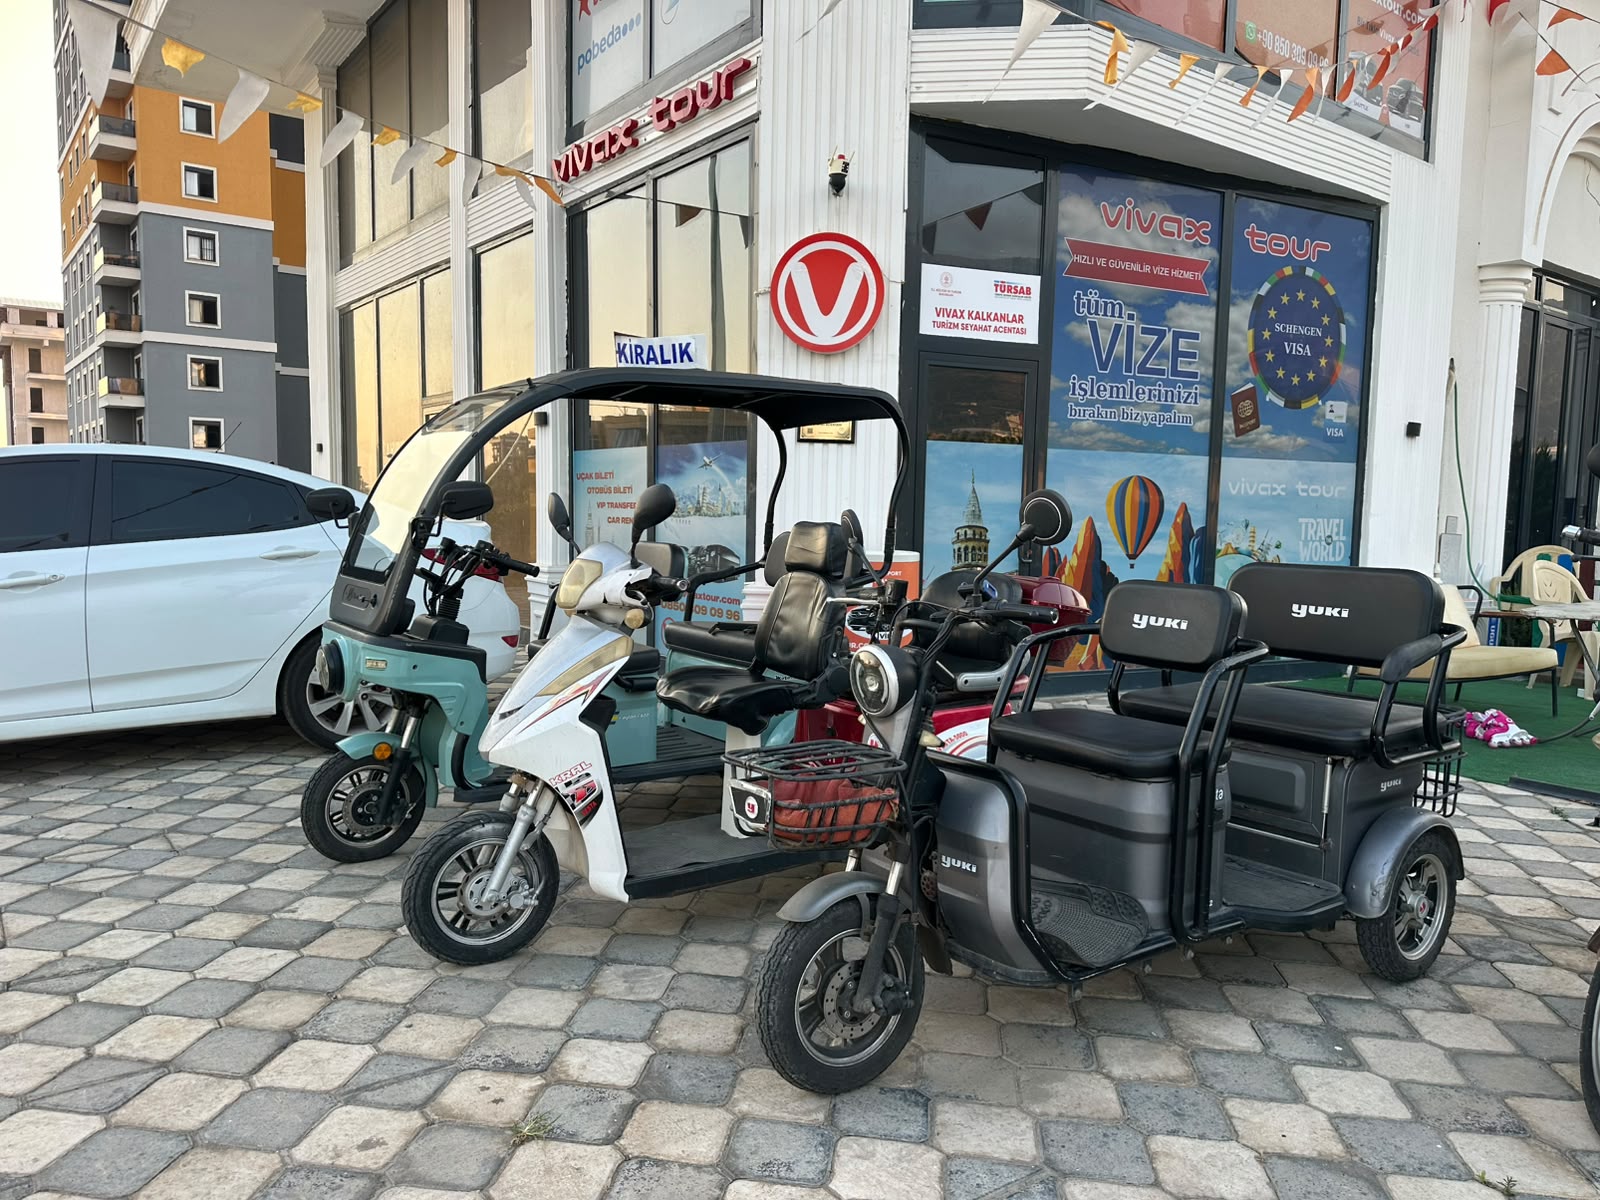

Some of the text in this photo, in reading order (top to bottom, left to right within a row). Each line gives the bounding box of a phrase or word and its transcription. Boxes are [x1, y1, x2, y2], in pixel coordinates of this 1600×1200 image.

[577, 23, 622, 75] pobeda
[1257, 29, 1273, 50] +90
[1274, 35, 1290, 59] 850
[1291, 44, 1306, 65] 309
[1307, 52, 1318, 69] 09
[551, 57, 752, 183] vivax tour
[1100, 197, 1212, 245] vivax
[1244, 222, 1332, 263] tour
[1073, 254, 1095, 265] HIZLI
[1096, 257, 1107, 267] VE
[1108, 258, 1151, 273] GÜVENİLİR
[1152, 264, 1170, 276] VİZE
[994, 280, 1032, 295] TÜRSAB
[1074, 289, 1124, 319] tüm
[935, 307, 1025, 324] VIVAX KALKANLAR
[932, 320, 1027, 335] TURİZM SEYAHAT ACENTASI
[1274, 322, 1322, 338] SCHENGEN
[617, 338, 694, 365] KİRALIK
[1087, 312, 1201, 381] VİZE
[1283, 341, 1312, 357] VISA
[1069, 375, 1199, 405] işlemlerinizi
[1067, 403, 1193, 426] bırakın biz yapalım
[1326, 427, 1344, 437] VISA
[576, 470, 615, 482] UÇAK BİLETİ
[587, 485, 633, 494] OTOBÜS BİLETİ
[1228, 478, 1347, 497] vivax tour
[1298, 518, 1347, 541] TRAVEL
[1298, 541, 1345, 562] WORLD
[710, 607, 724, 618] 09
[726, 610, 740, 621] 96
[1291, 603, 1350, 618] yuki
[1132, 613, 1189, 630] yuki
[549, 761, 593, 787] KRAL
[1380, 778, 1402, 792] yuki
[940, 855, 977, 873] yuki
